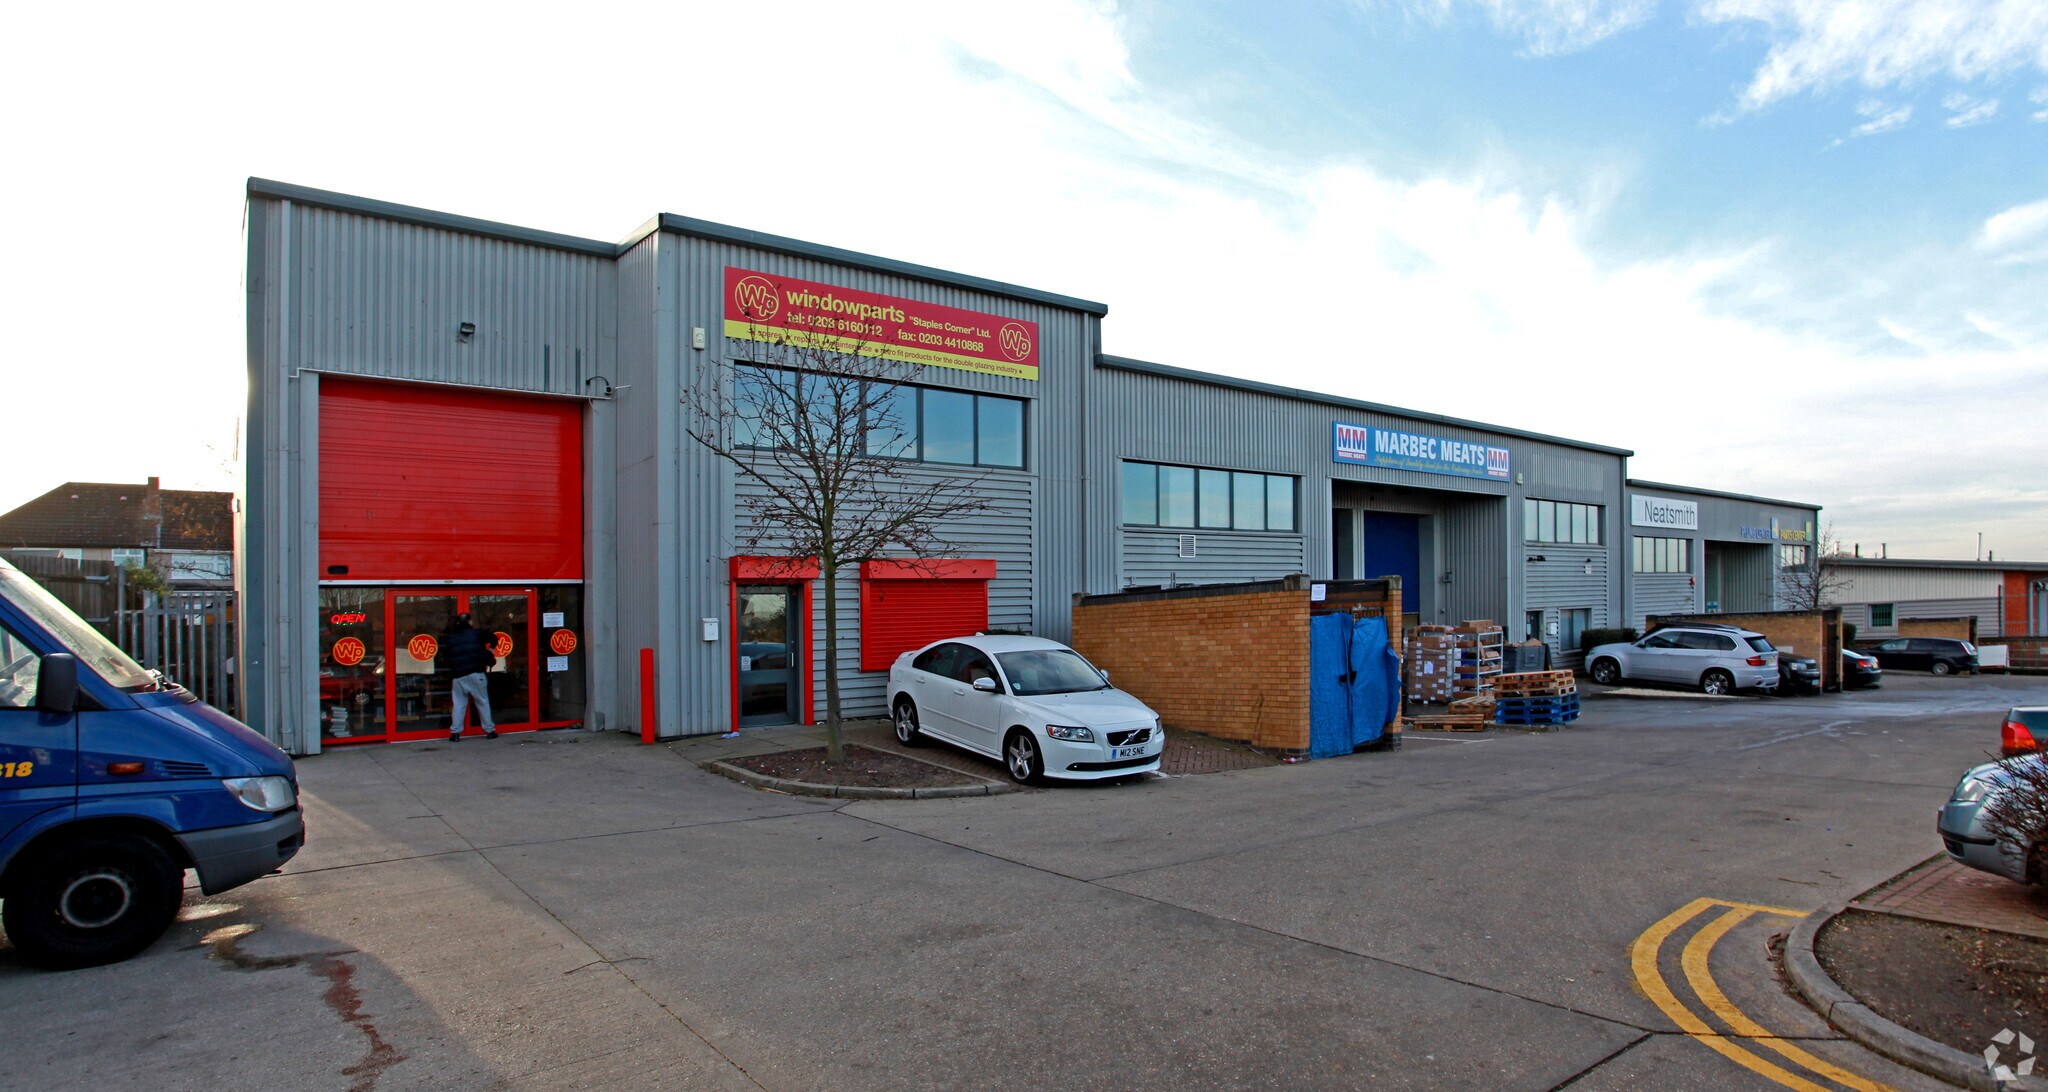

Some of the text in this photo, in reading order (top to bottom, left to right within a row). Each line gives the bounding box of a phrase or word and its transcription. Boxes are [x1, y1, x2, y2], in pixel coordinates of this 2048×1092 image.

[786, 289, 905, 323] windowparts
[977, 327, 991, 338] Ltd.
[787, 312, 805, 325] tel:
[838, 319, 882, 337] 6160112
[898, 329, 916, 342] fax:
[919, 333, 942, 346] 0203
[945, 337, 984, 353] 4410868
[1000, 326, 1031, 358] Wp
[905, 351, 932, 362] products
[943, 356, 953, 364] the
[954, 358, 973, 367] double
[975, 361, 995, 372] glazing
[996, 365, 1018, 374] industry
[1338, 427, 1366, 450] MM
[1375, 430, 1484, 466] MARBEC MEATS
[1488, 449, 1508, 469] MM
[1644, 500, 1696, 526] Neatsmith
[331, 613, 367, 624] OPEN
[335, 642, 365, 662] Wp
[409, 638, 438, 661] Wp
[552, 633, 577, 652] Wp
[0, 761, 33, 778] 18
